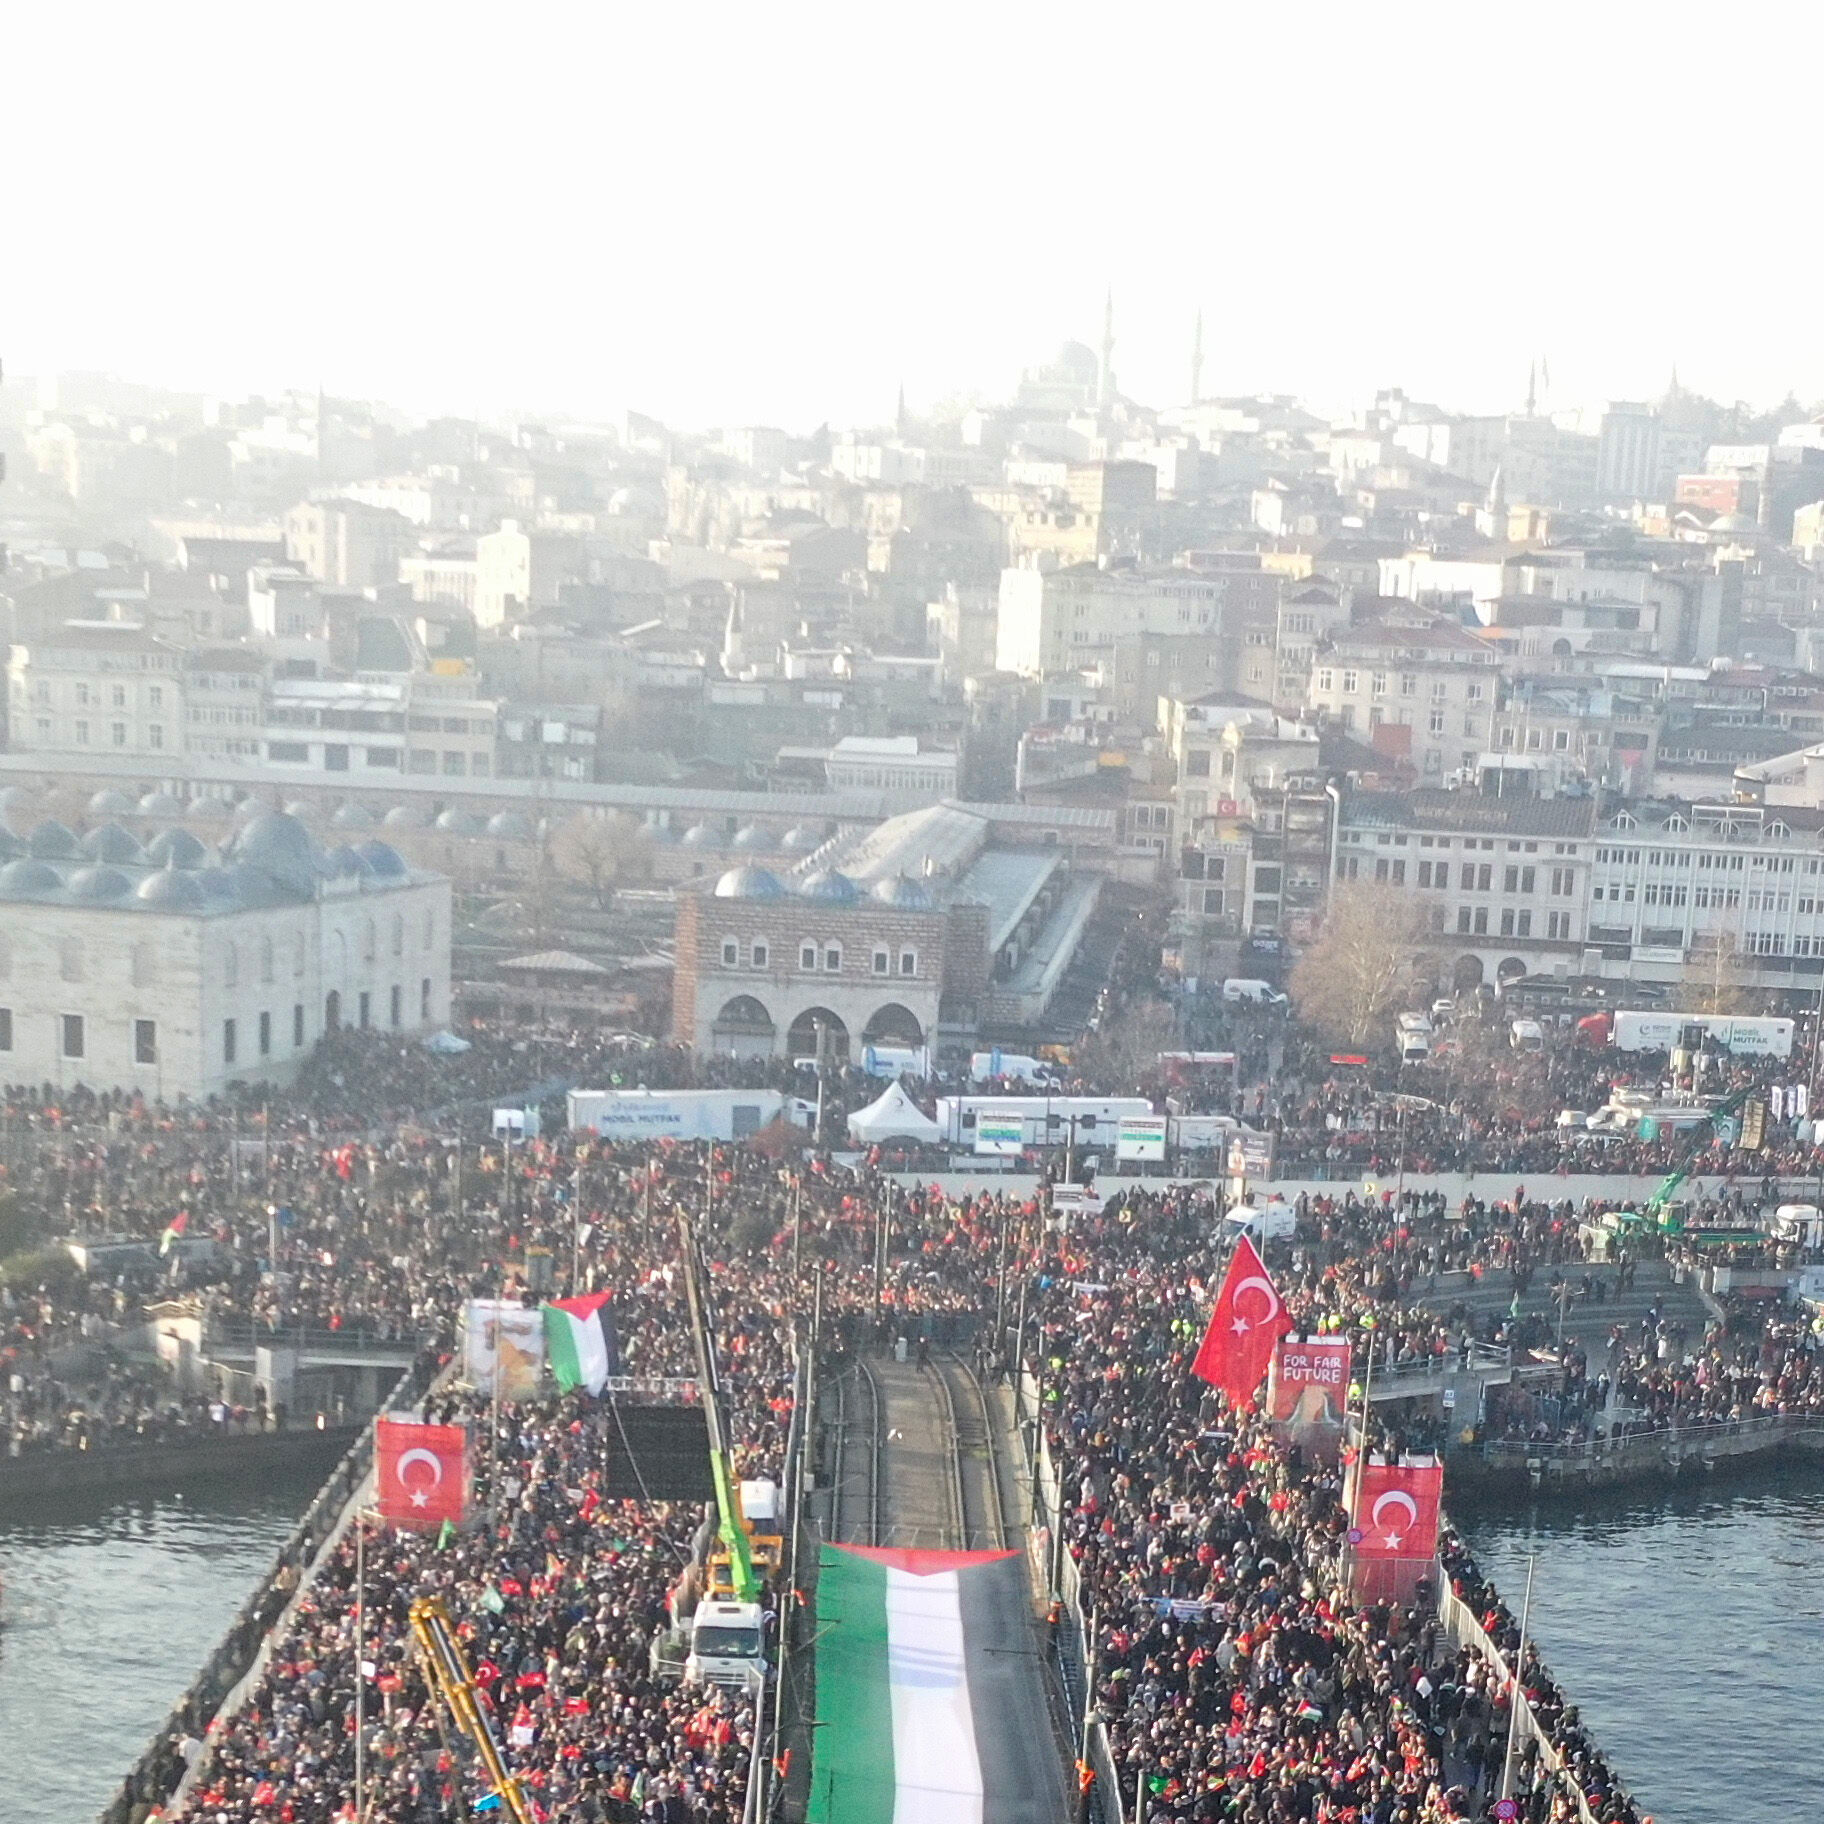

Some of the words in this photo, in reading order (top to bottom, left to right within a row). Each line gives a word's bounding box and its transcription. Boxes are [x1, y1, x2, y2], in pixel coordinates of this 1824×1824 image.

[1283, 1354, 1308, 1367] FOR
[1314, 1356, 1342, 1369] FAIR
[1283, 1366, 1341, 1384] FUTURE
